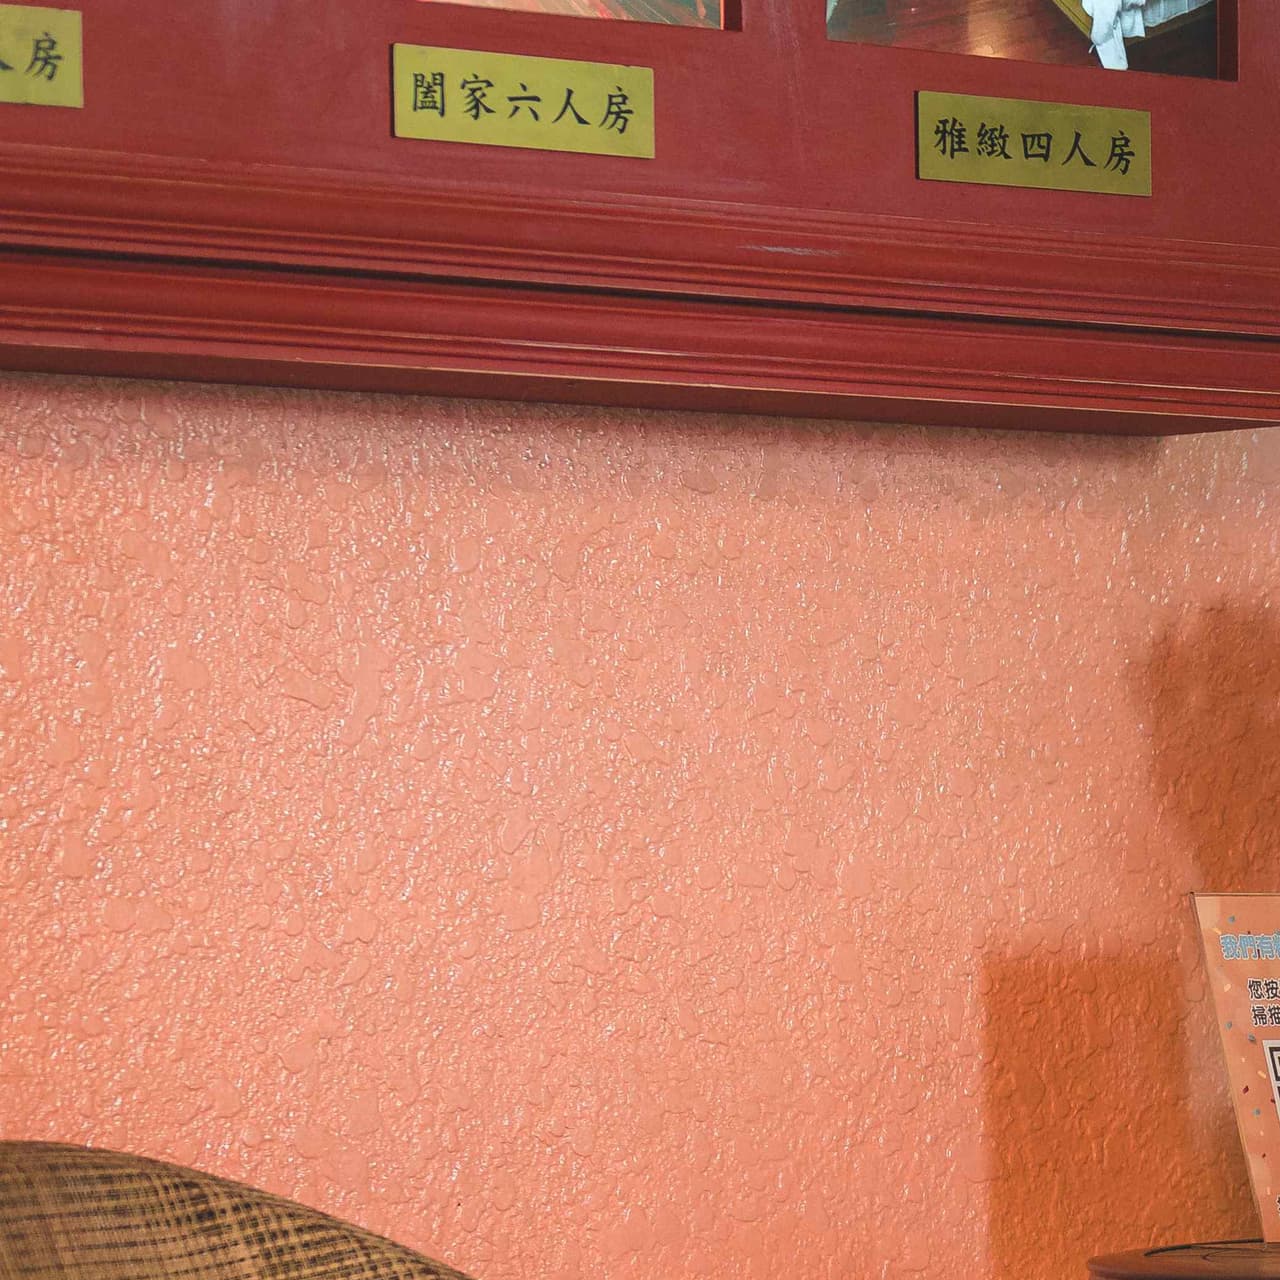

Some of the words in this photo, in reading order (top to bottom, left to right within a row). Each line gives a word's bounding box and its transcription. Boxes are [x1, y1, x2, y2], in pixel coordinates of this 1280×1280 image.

[413, 72, 634, 134] 闔家六人房
[934, 117, 1136, 175] 雅緻四人房
